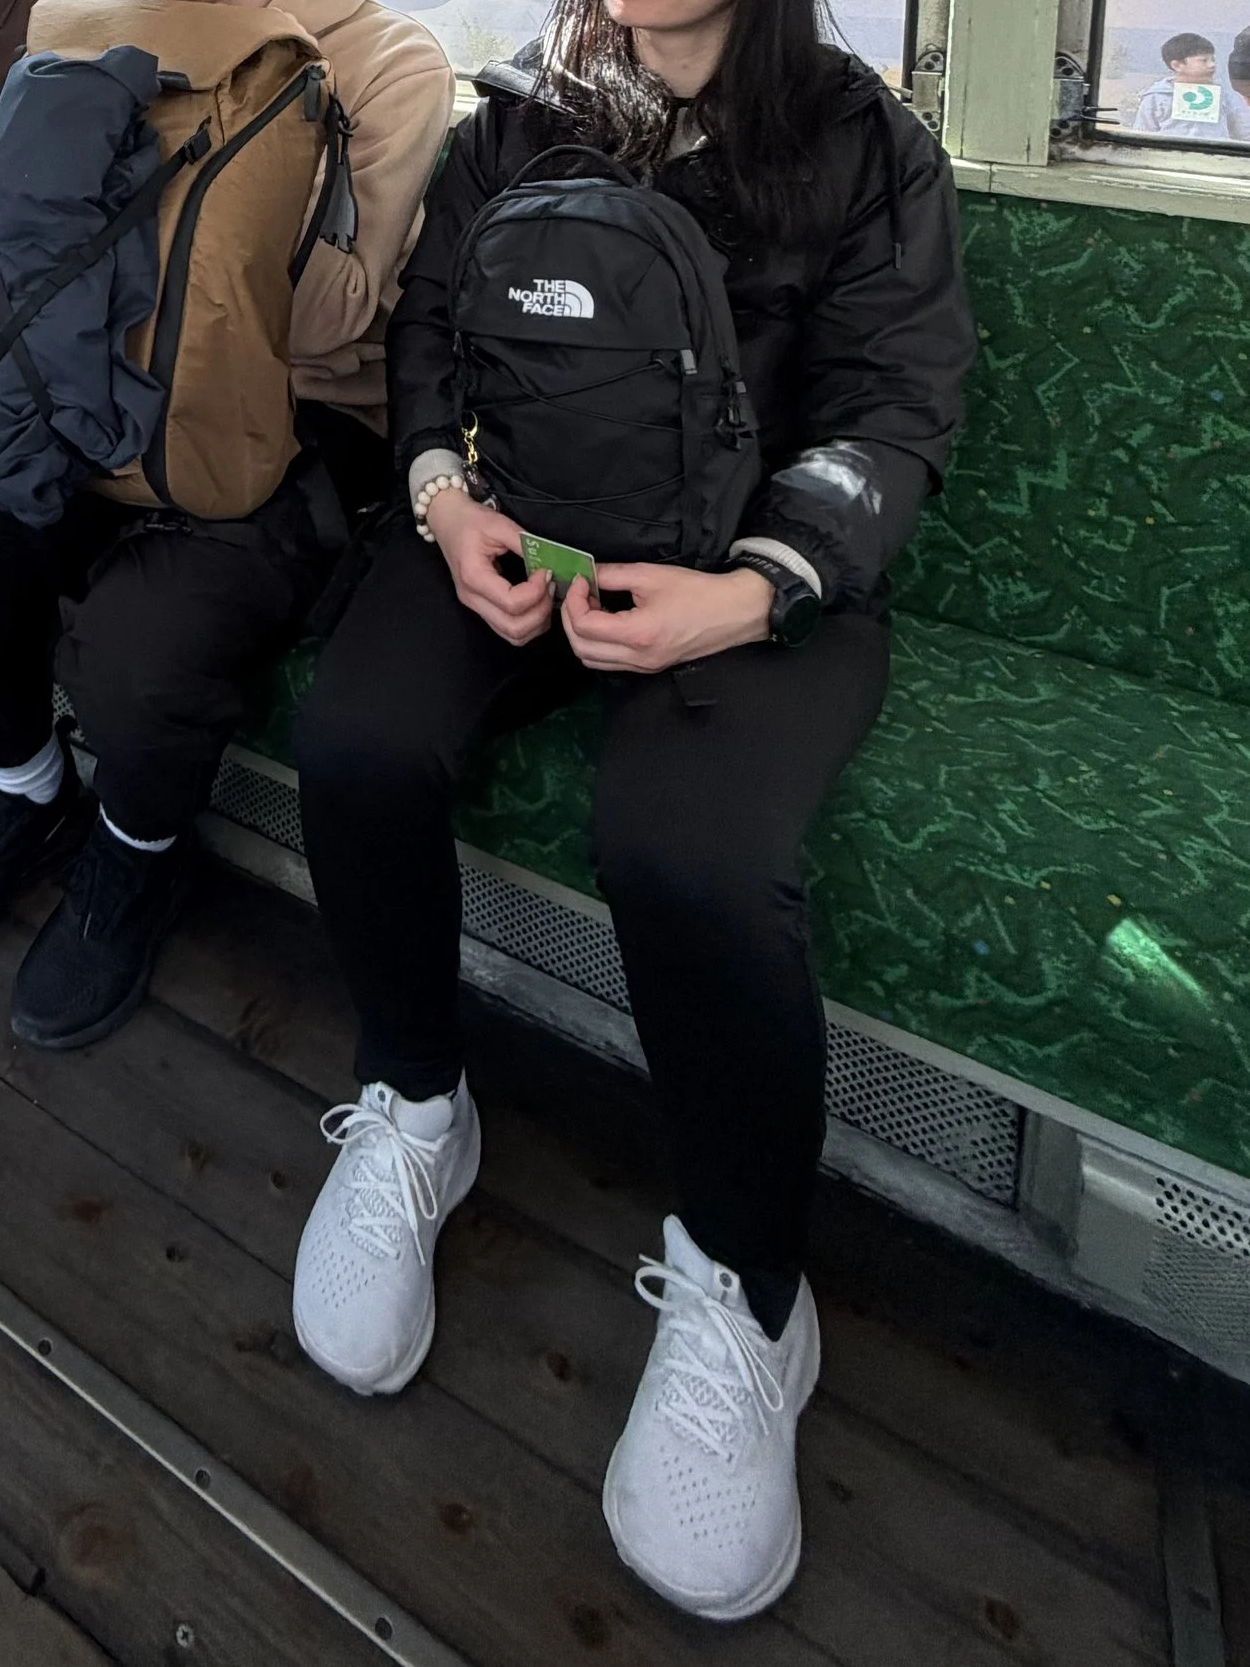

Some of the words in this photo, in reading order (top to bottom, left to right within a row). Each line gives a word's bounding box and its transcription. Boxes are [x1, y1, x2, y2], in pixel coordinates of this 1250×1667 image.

[533, 279, 565, 293] THE
[508, 287, 565, 305] NORTH
[522, 302, 565, 317] FACE
